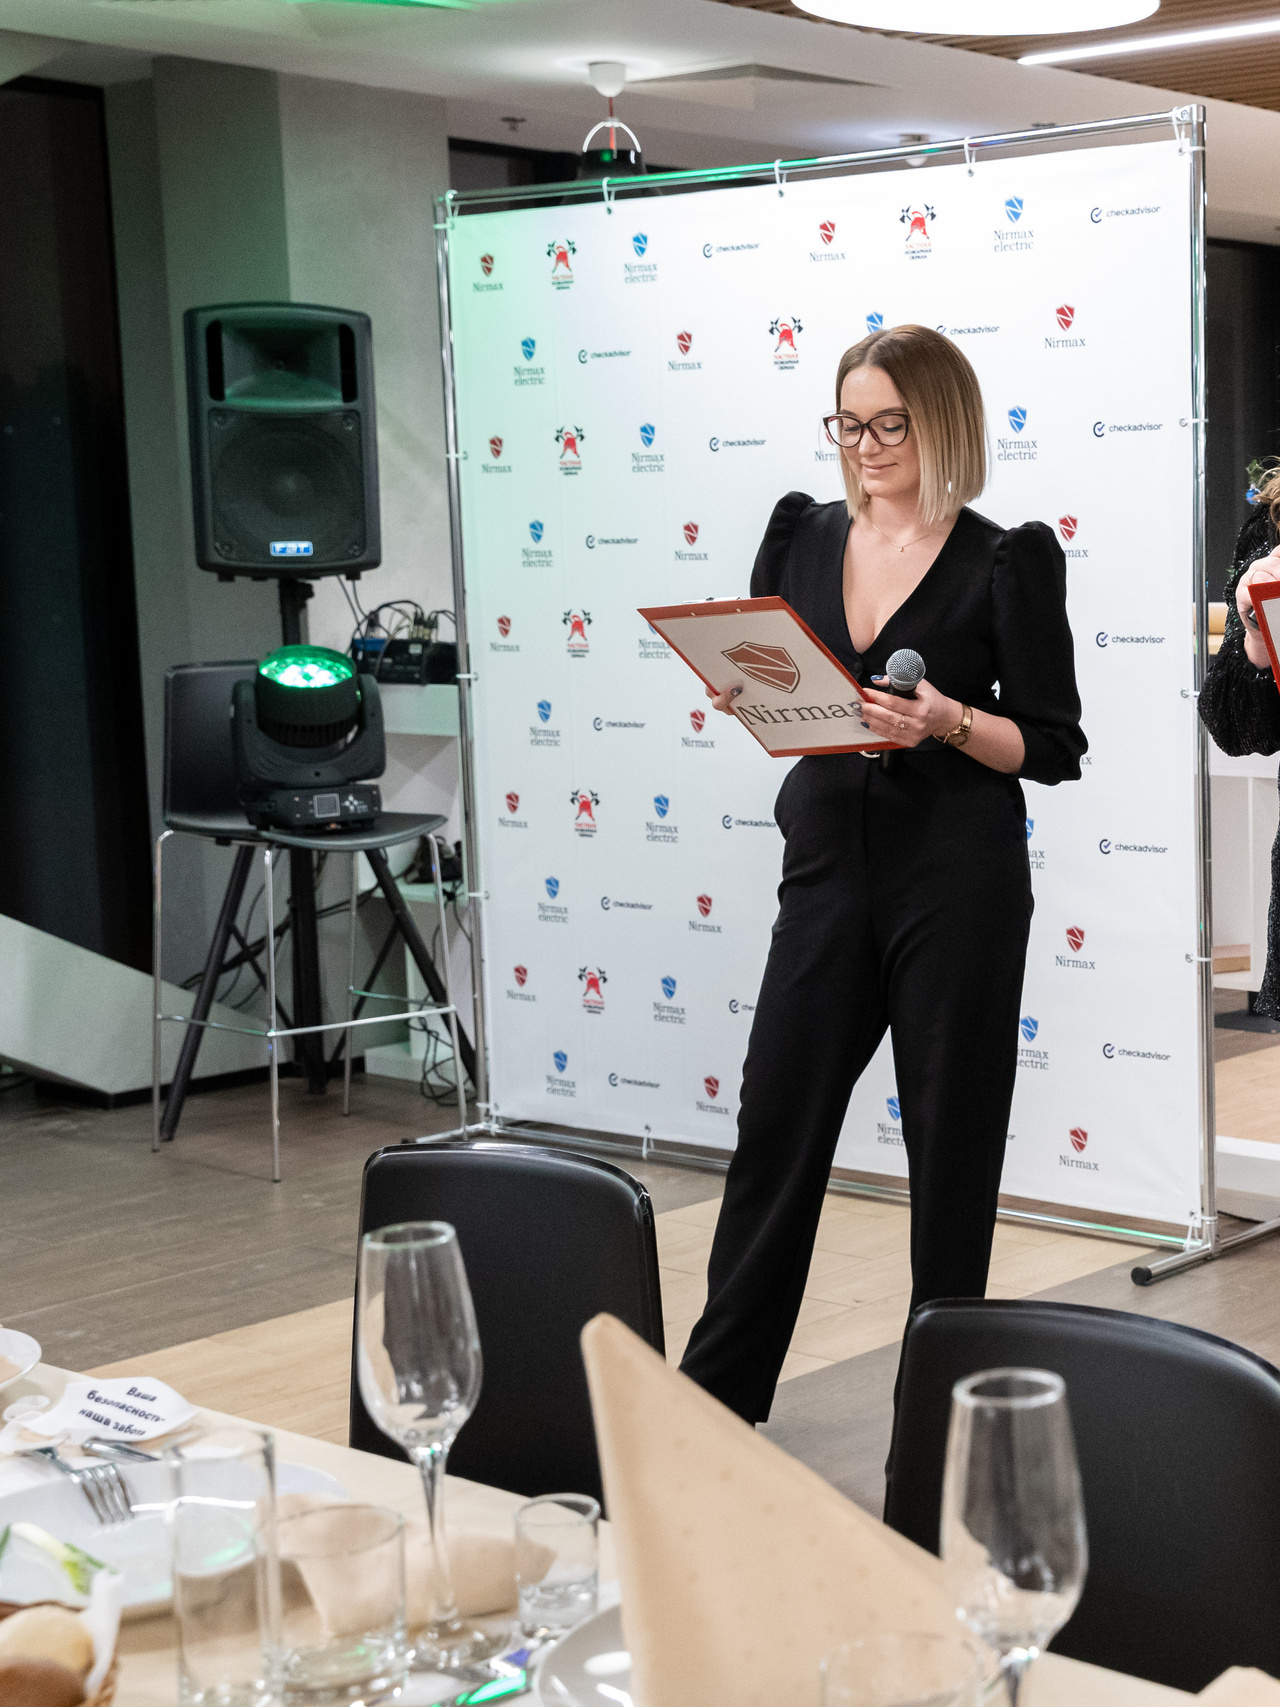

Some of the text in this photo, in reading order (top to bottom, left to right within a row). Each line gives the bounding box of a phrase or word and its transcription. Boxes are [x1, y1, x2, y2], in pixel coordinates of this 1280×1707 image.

[1106, 206, 1161, 217] checkadvisor
[994, 230, 1034, 240] Nirmax
[994, 241, 1033, 252] electric
[810, 253, 845, 262] Nirmax
[624, 264, 657, 273] Nirmax
[950, 326, 1000, 335] checkadvisor
[1045, 338, 1085, 348] Nirmax
[668, 361, 702, 371] Nirmax
[1109, 423, 1163, 432] checkadvisor
[998, 439, 1037, 449] Nirmax
[632, 452, 664, 462] Nirmax
[814, 451, 838, 461] Nirm
[998, 448, 1037, 460] electric
[675, 551, 708, 560] Nirmax
[1064, 549, 1089, 558] max
[1112, 635, 1165, 644] checkadvisor
[736, 704, 854, 726] Nirma
[682, 737, 715, 748] Nirmax
[646, 822, 678, 832] Nirmax
[735, 819, 777, 828] checkadviso
[1115, 844, 1168, 853] checkadvisor
[689, 921, 722, 933] Nirmax
[1056, 956, 1095, 969] Nirmax
[653, 1002, 686, 1014] Nirmax
[1018, 1048, 1049, 1060] rmax
[1118, 1049, 1171, 1060] checkadvisor
[1018, 1058, 1049, 1070] ectric
[696, 1101, 729, 1115] Nirmax
[877, 1122, 902, 1136] Nirm
[1059, 1155, 1099, 1170] Nirmax
